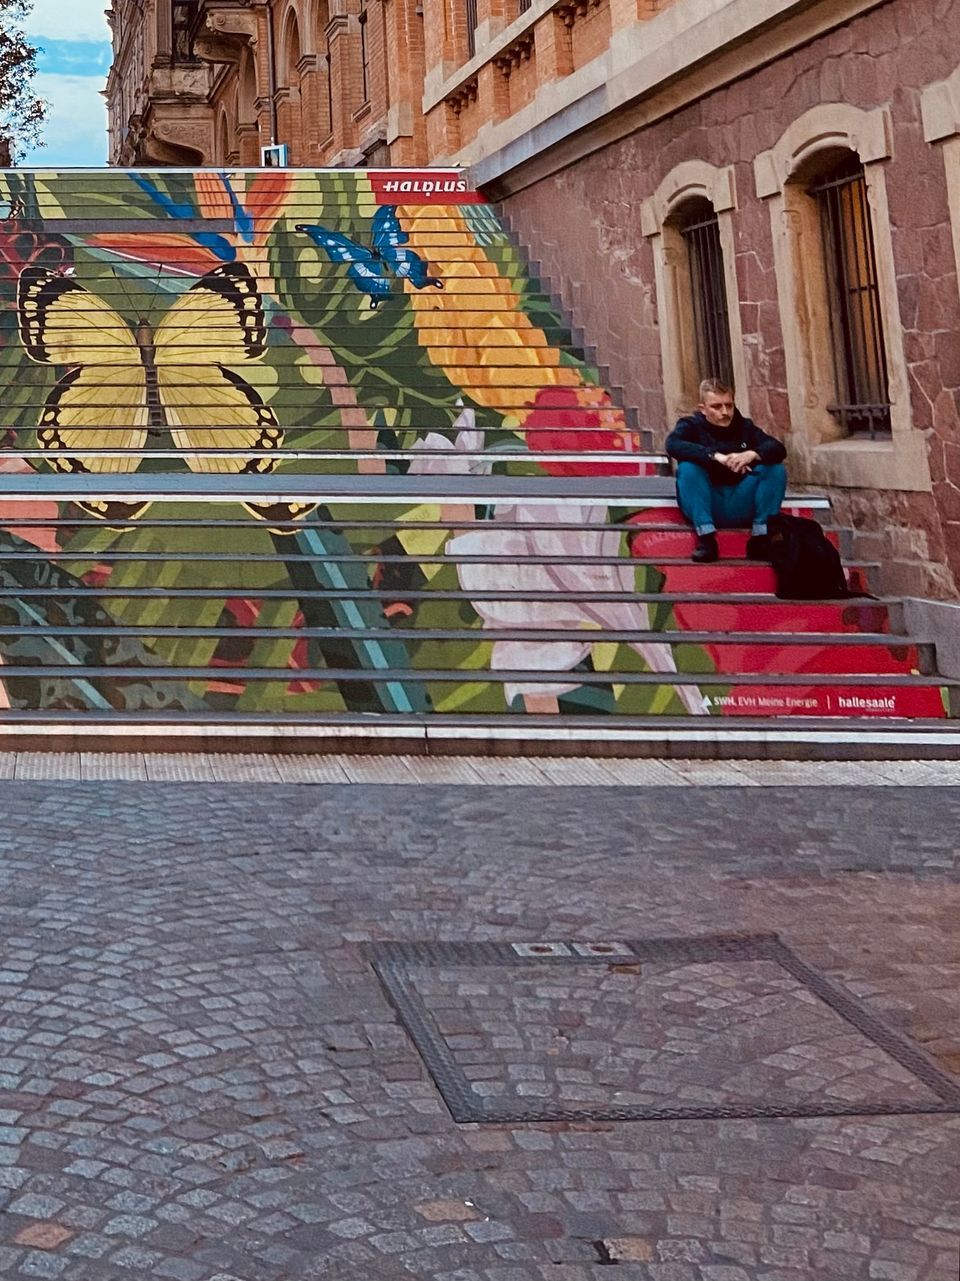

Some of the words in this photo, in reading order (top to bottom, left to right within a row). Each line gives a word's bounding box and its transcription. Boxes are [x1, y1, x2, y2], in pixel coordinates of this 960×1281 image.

[738, 696, 756, 706] EVH
[758, 697, 785, 707] Meine
[786, 697, 818, 708] Energie
